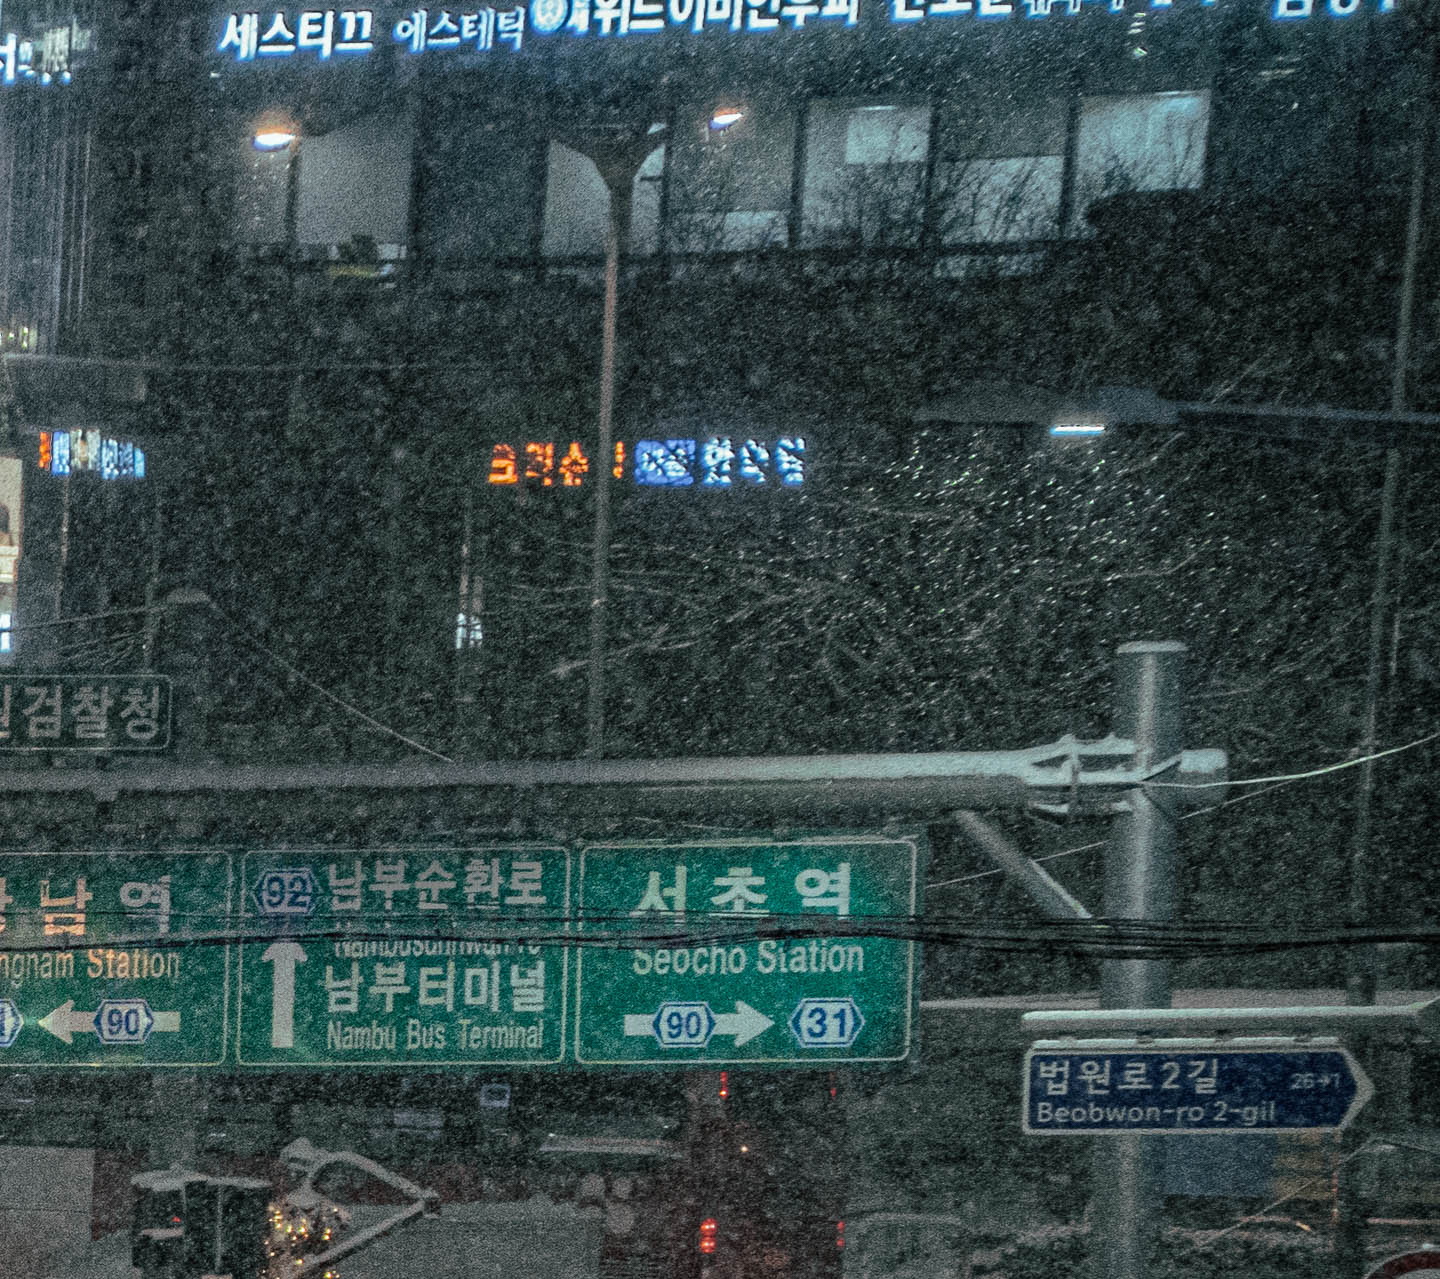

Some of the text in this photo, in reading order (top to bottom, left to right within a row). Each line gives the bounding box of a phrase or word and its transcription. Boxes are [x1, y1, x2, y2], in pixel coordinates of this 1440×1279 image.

[394, 8, 525, 52] 에스테틱
[266, 876, 309, 908] 92
[328, 859, 547, 911] 남부순환로
[630, 862, 851, 924] 서초역
[87, 949, 180, 979] Station
[632, 940, 864, 975] Seocho Station
[325, 960, 545, 1012] 남부터미널
[107, 1008, 141, 1036] 90
[327, 1018, 544, 1051] Nambu Bus Terminal
[666, 1011, 702, 1039] 90
[807, 1007, 847, 1038] 31
[1039, 1059, 1218, 1096] 법원로2길
[1037, 1101, 1276, 1126] Beobwon-ro 2-gil
